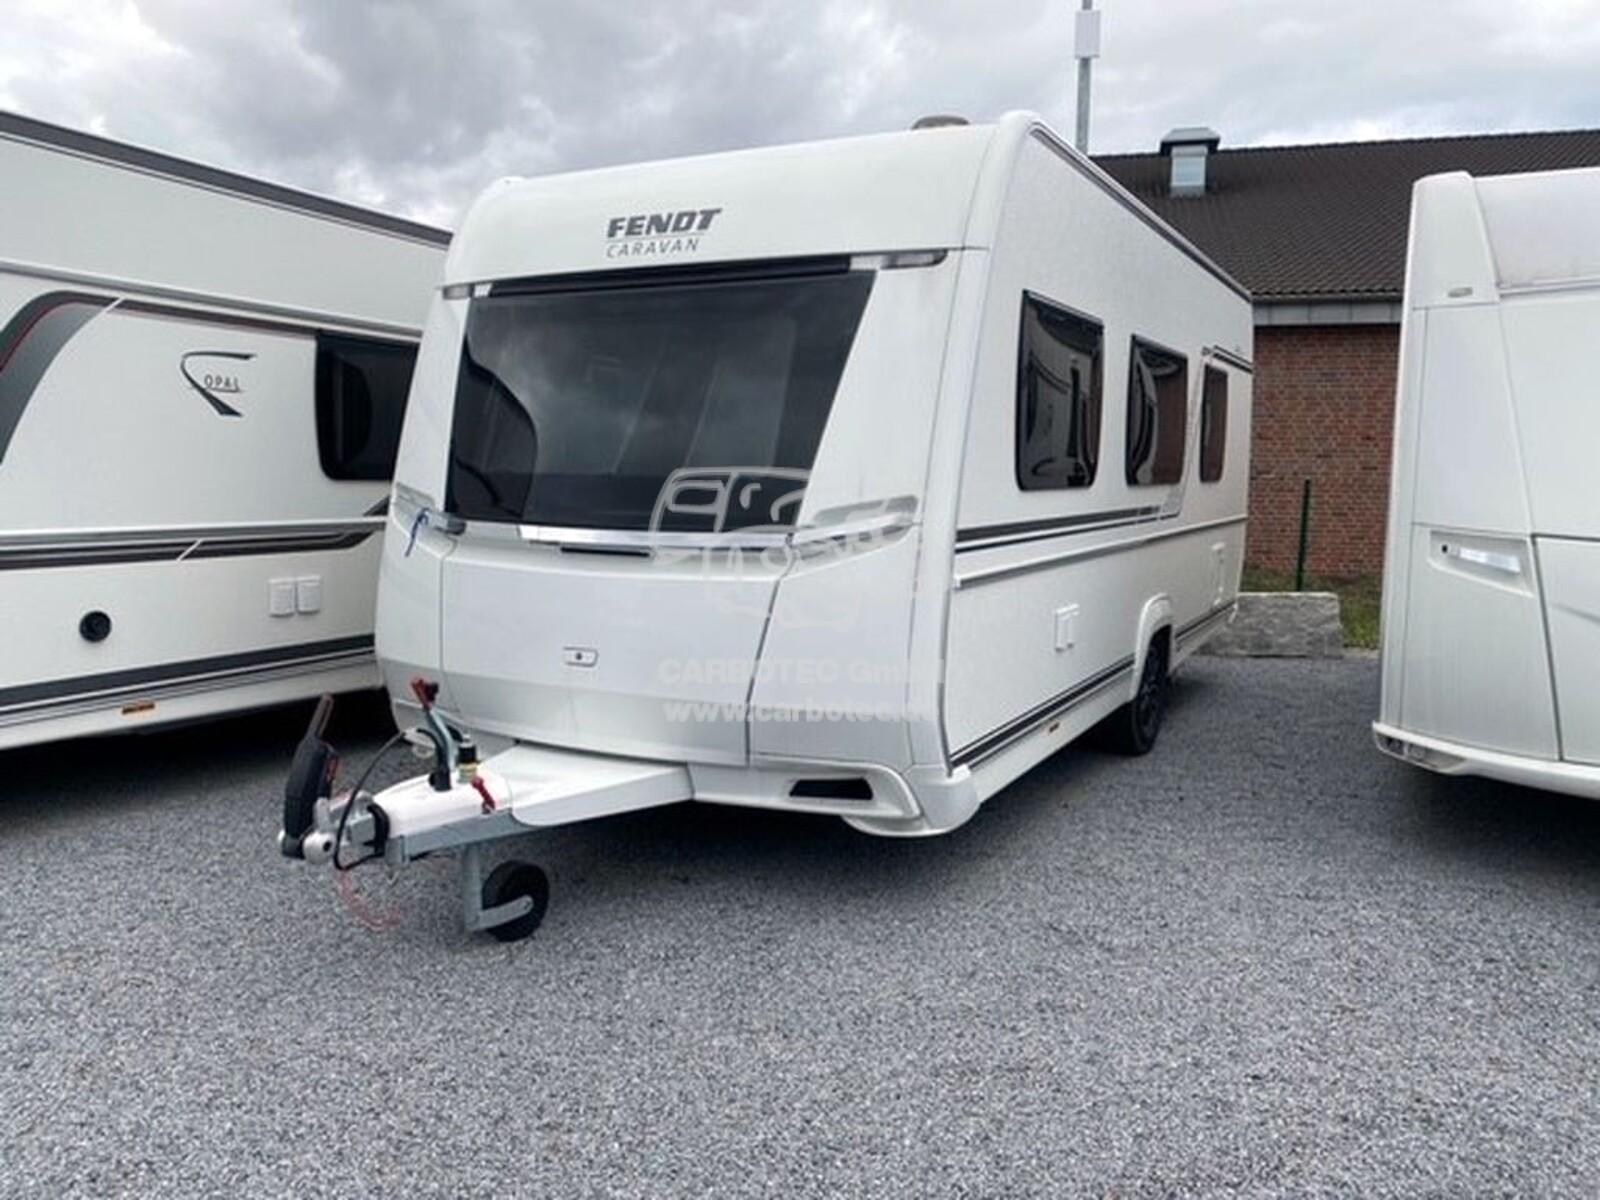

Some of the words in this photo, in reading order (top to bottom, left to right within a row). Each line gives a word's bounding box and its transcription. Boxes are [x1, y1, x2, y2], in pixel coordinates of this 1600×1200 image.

[607, 207, 722, 238] FENDT
[606, 237, 700, 258] CARAVAN
[203, 374, 241, 393] OPAL
